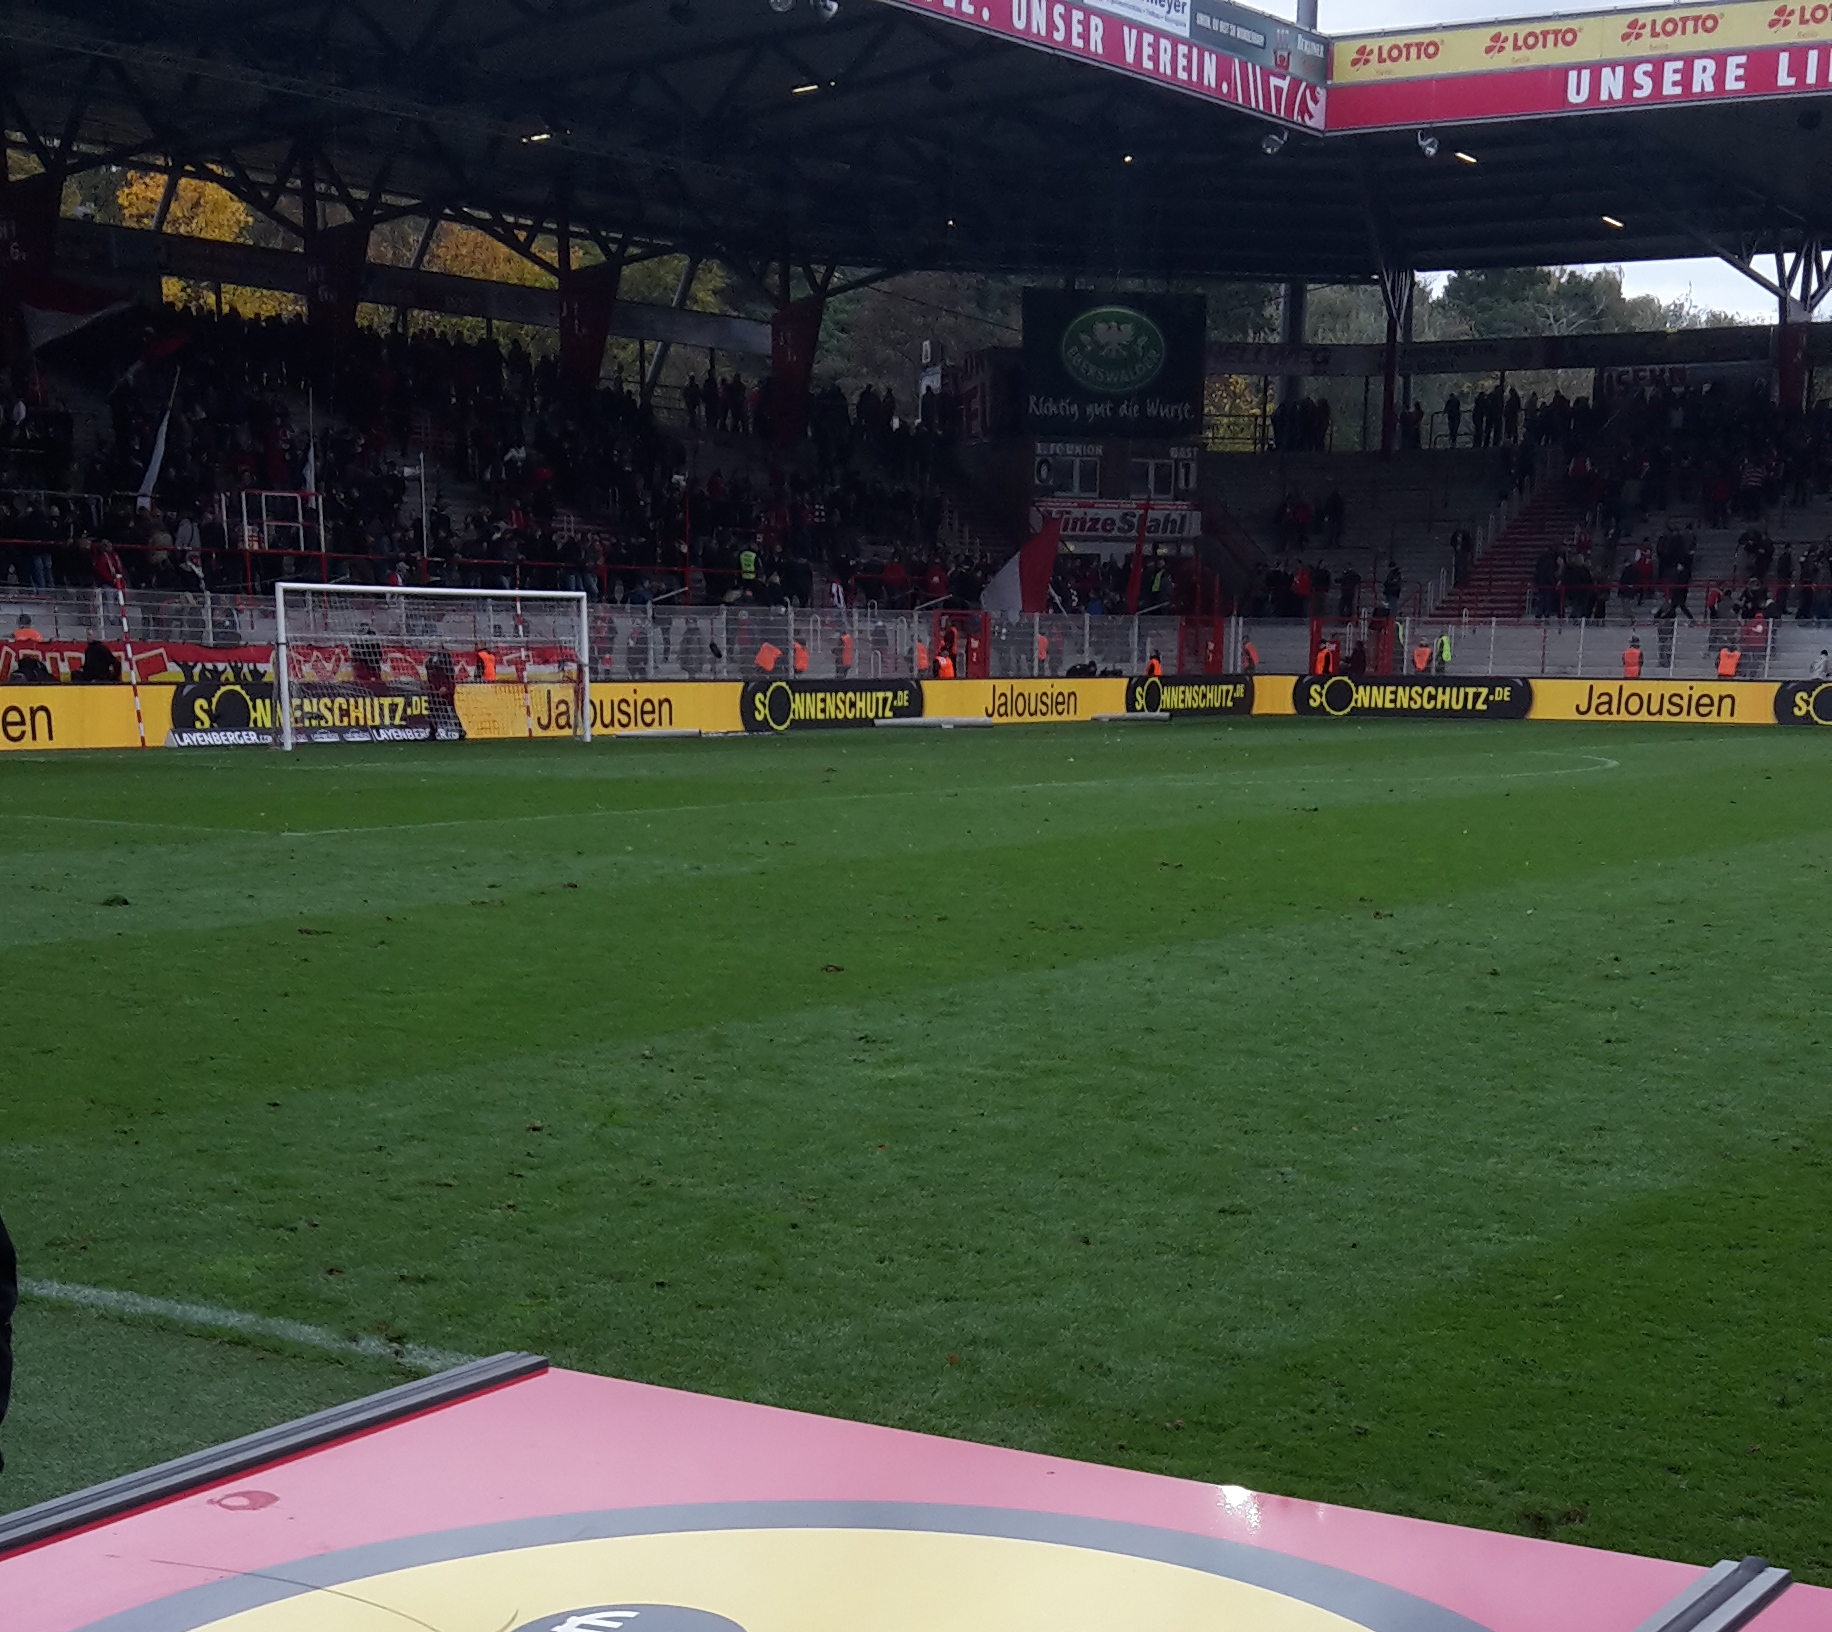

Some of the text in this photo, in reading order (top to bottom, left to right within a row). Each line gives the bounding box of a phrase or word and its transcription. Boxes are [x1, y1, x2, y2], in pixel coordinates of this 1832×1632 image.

[1650, 13, 1720, 39] LOTTO
[1799, 4, 1832, 25] LO
[1011, 0, 1104, 55] UNSER
[1122, 24, 1228, 94] VEREIN.
[1377, 40, 1440, 65] LOTTO
[1512, 27, 1577, 52] LOTTO
[1566, 48, 1832, 105] UNSERE LI
[537, 688, 673, 731] Jaousien
[754, 681, 910, 731] SONNENSCHUTZ.DE
[985, 682, 1078, 718] Jalousien
[1134, 677, 1245, 713] SONNENSCHUTZ.DE
[1308, 676, 1512, 716] SONNENSCHUTZ.DE
[1575, 684, 1737, 718] Jalousien
